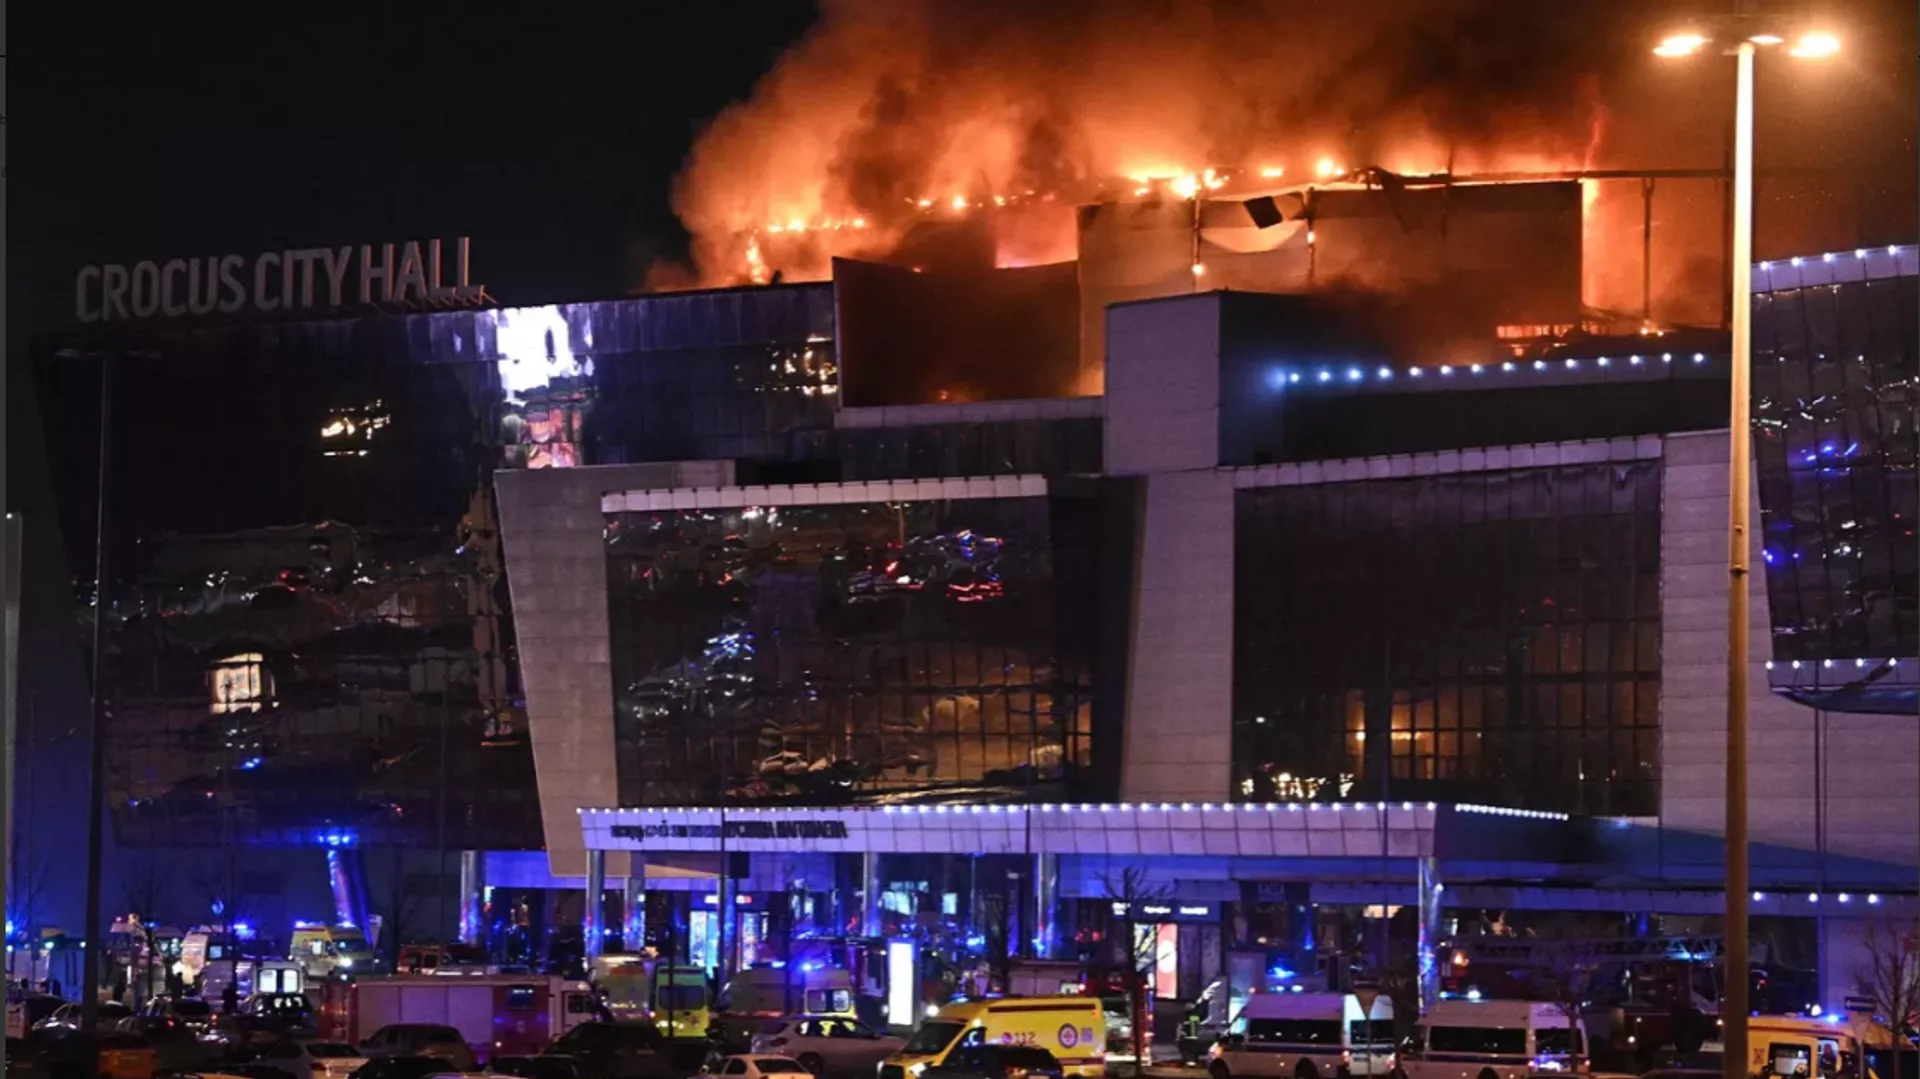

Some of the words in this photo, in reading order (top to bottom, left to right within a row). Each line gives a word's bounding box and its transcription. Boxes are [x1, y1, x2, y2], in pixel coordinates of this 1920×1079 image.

[75, 253, 247, 324] CROCUS
[253, 245, 353, 311] CITY
[359, 236, 485, 304] HALL
[1014, 1031, 1036, 1045] 112
